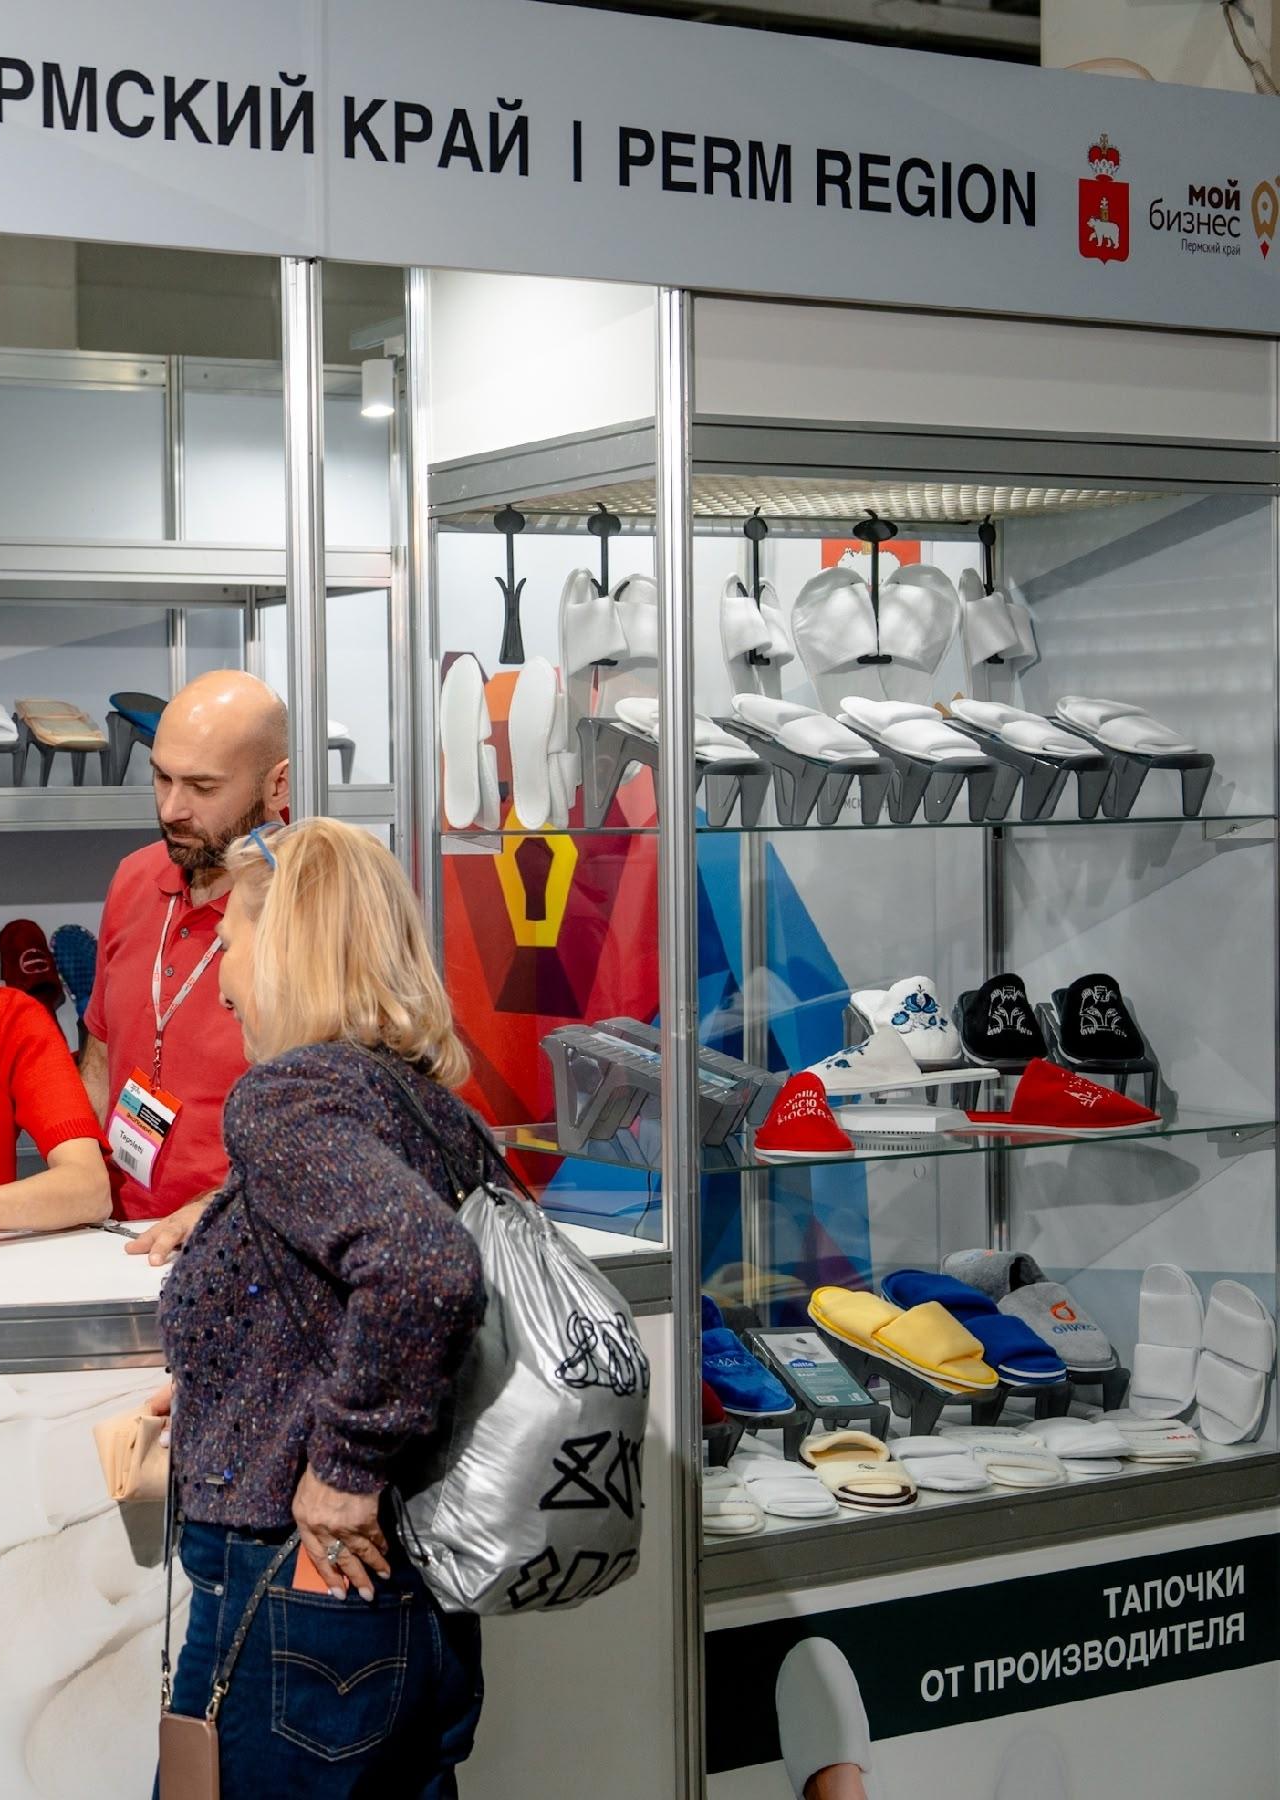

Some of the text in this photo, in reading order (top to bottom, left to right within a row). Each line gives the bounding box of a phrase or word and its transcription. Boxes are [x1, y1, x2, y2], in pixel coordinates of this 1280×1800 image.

[343, 96, 529, 177] КРАЙ
[619, 126, 792, 204] PERM
[816, 148, 1036, 227] REGION
[1149, 197, 1241, 238] бизнес
[1181, 238, 1241, 257] Пермский край
[1102, 1564, 1246, 1619] ТАПОЧКИ
[920, 1611, 1246, 1702] ОТ ПРОИЗВОДИТЕЛЯ
